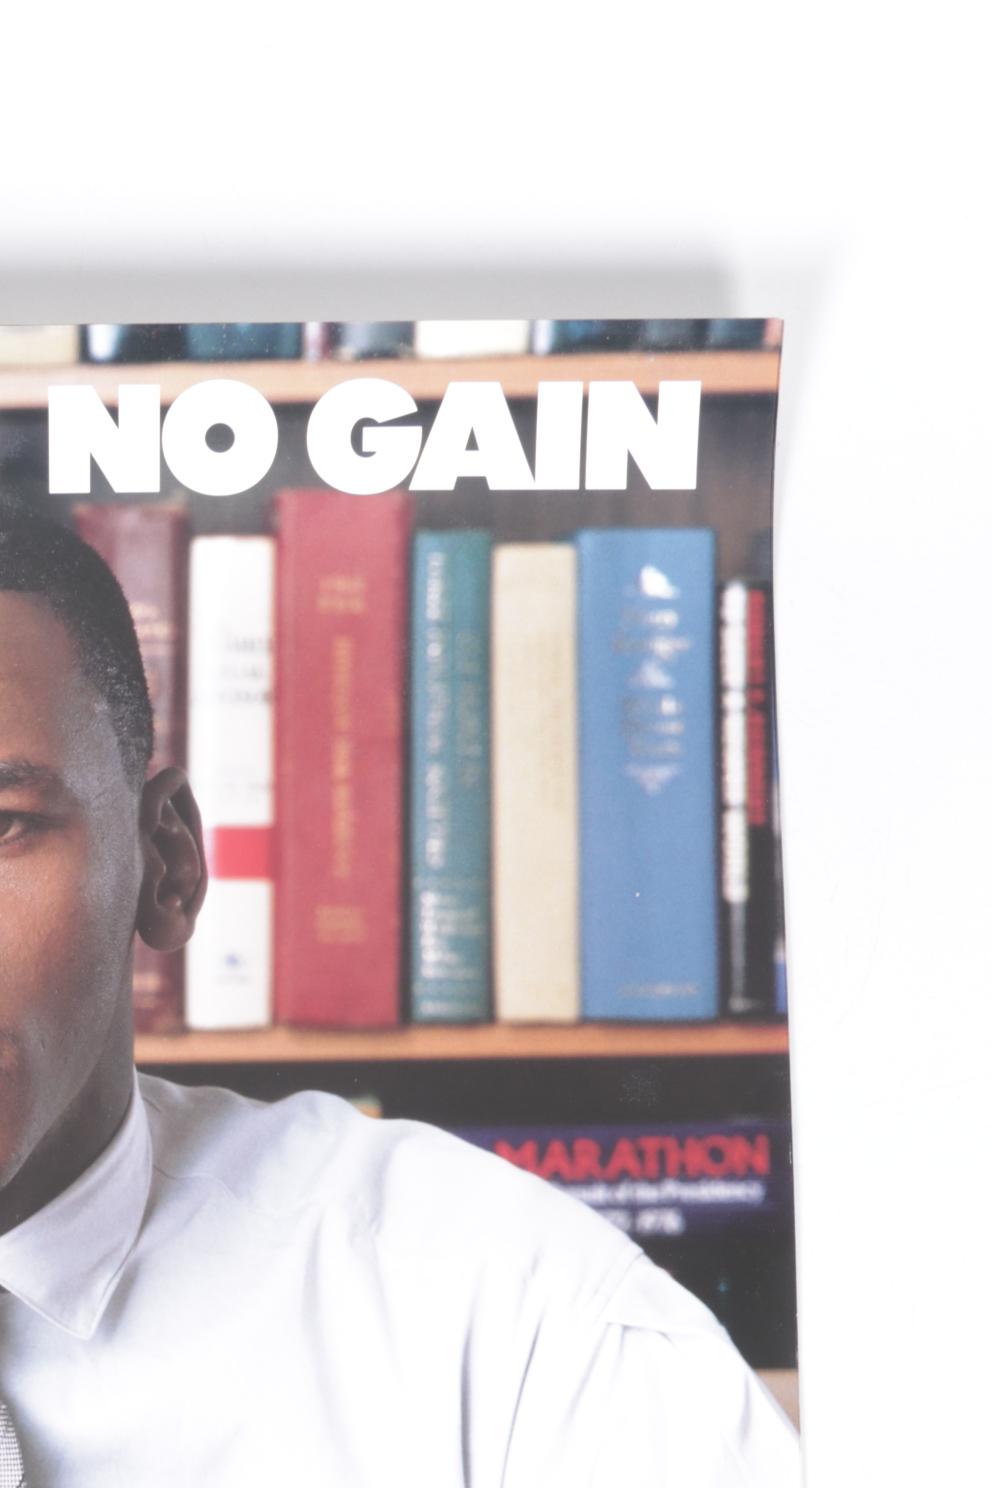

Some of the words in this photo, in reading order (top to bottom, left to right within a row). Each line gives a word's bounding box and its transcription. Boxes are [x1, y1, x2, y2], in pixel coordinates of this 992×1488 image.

[48, 378, 278, 496] NO
[306, 377, 702, 496] GAIN
[493, 1134, 770, 1181] MARATHON
